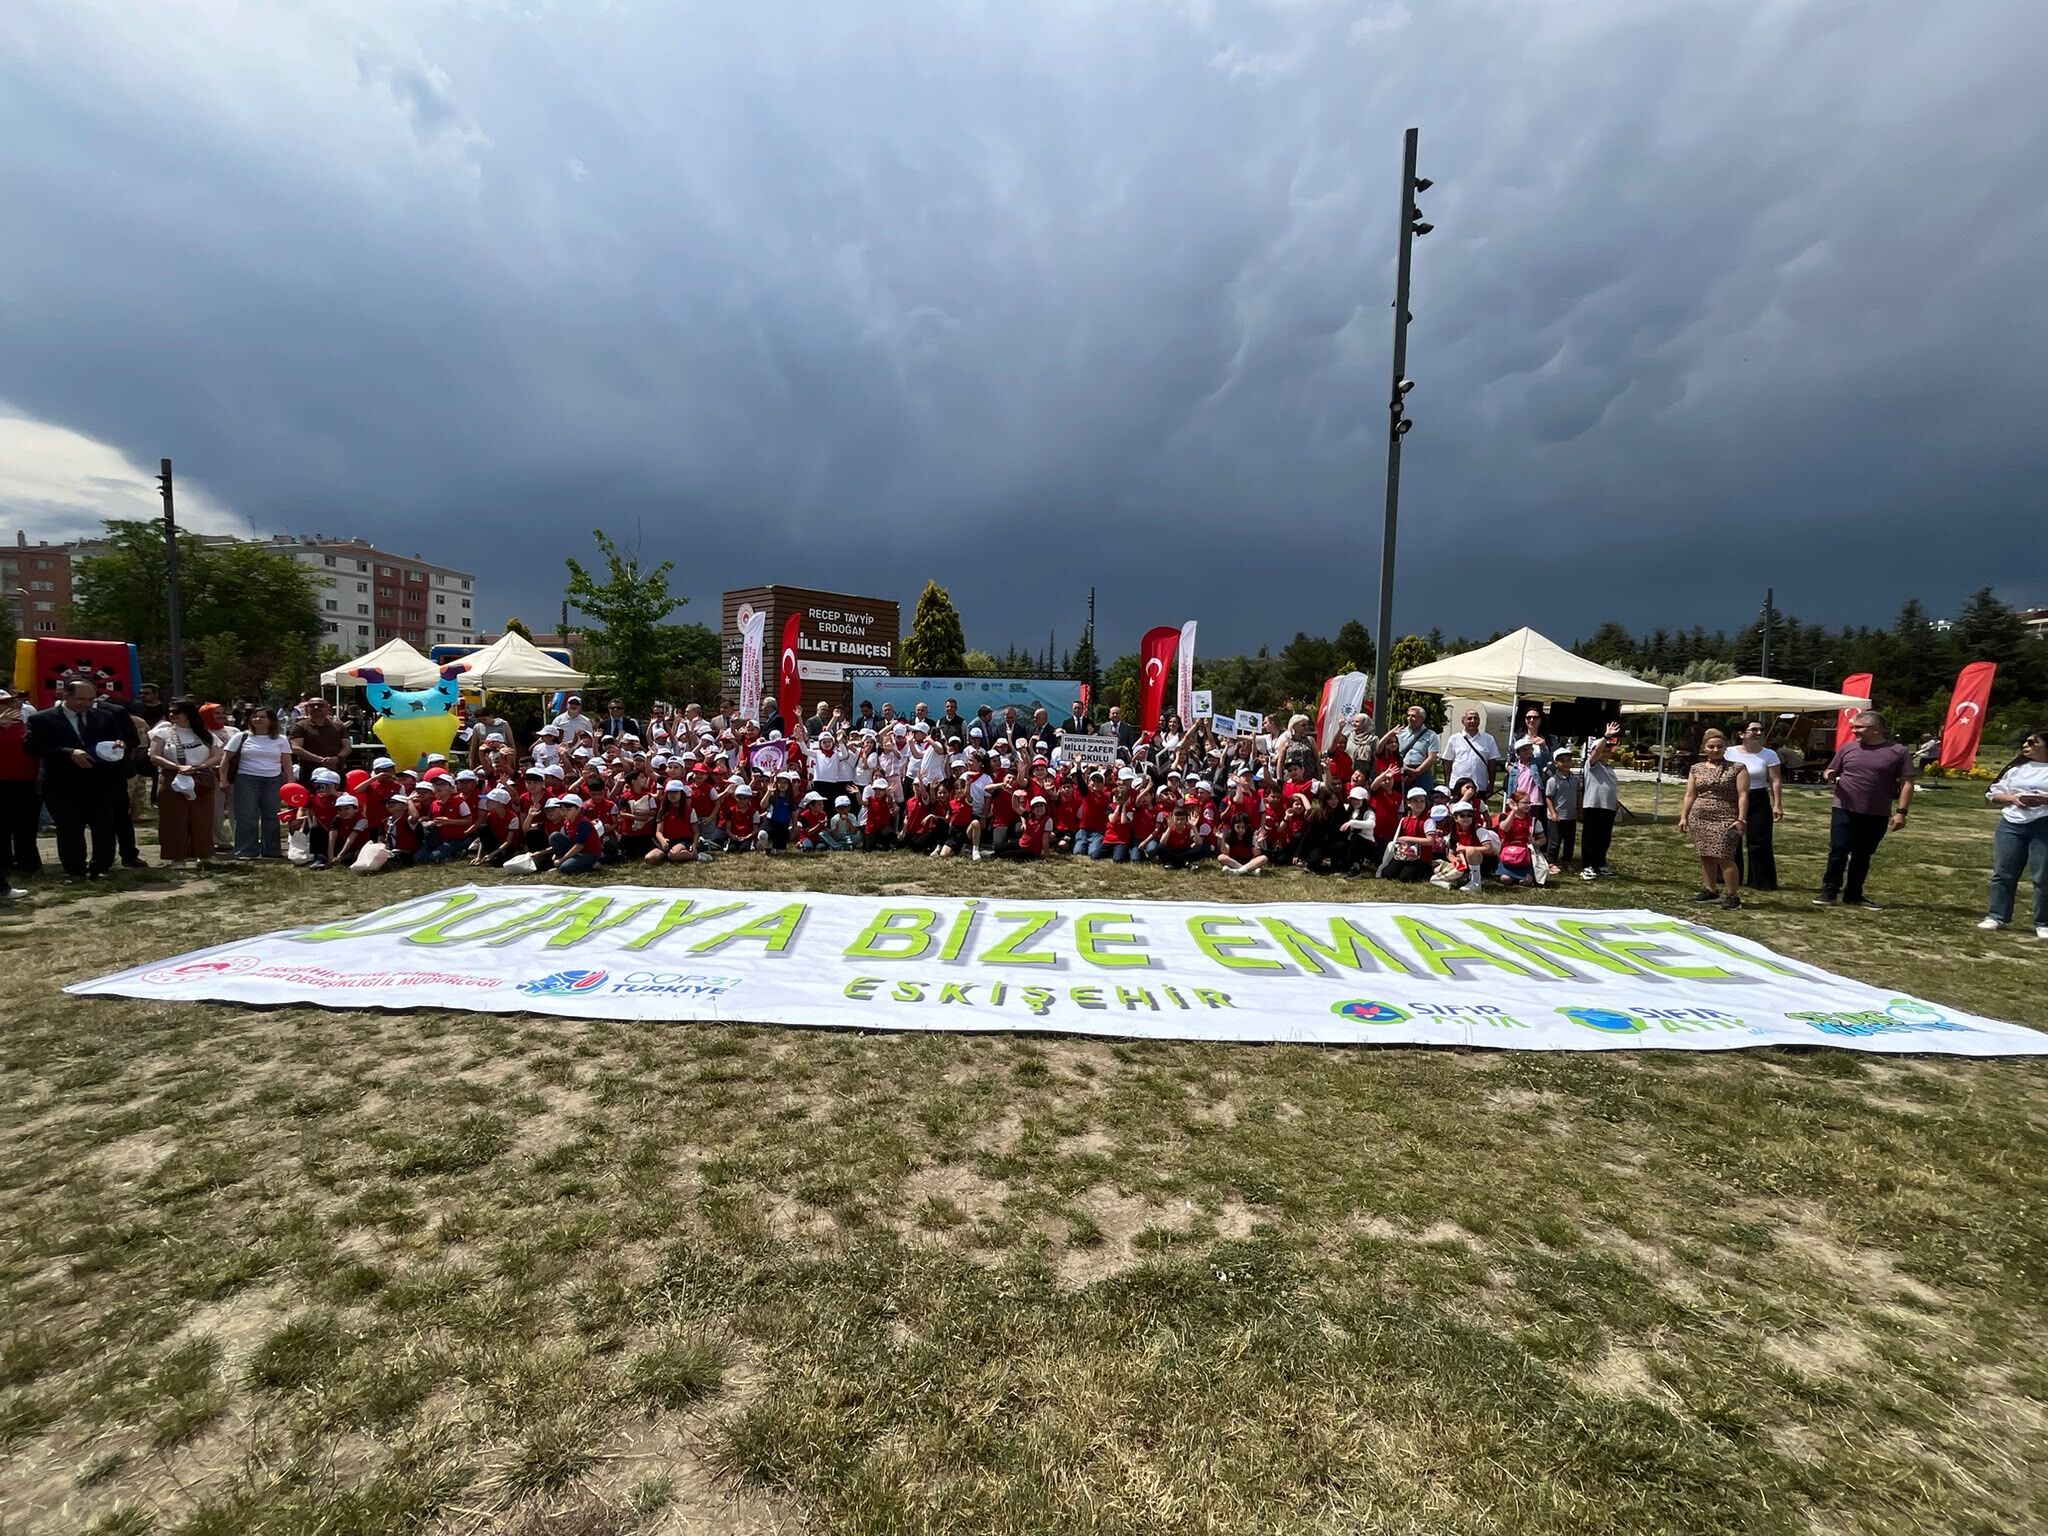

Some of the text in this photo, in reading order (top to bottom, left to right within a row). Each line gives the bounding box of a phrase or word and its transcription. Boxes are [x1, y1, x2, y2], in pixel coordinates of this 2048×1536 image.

[808, 608, 875, 625] RECEP TAYYİP
[818, 622, 866, 637] ERDOĞAN
[797, 632, 892, 659] İLLET BAHÇESİ
[1064, 743, 1114, 754] MİLLİ ZAFER
[1068, 752, 1109, 763] İLOKULU
[298, 890, 1804, 980] DÜNYA BİZE EMANET
[624, 971, 743, 987] COP31
[611, 983, 729, 995] TÜRKİYE
[843, 976, 1231, 1013] ESKİŞEHİR
[1407, 1002, 1510, 1016] SIFIR
